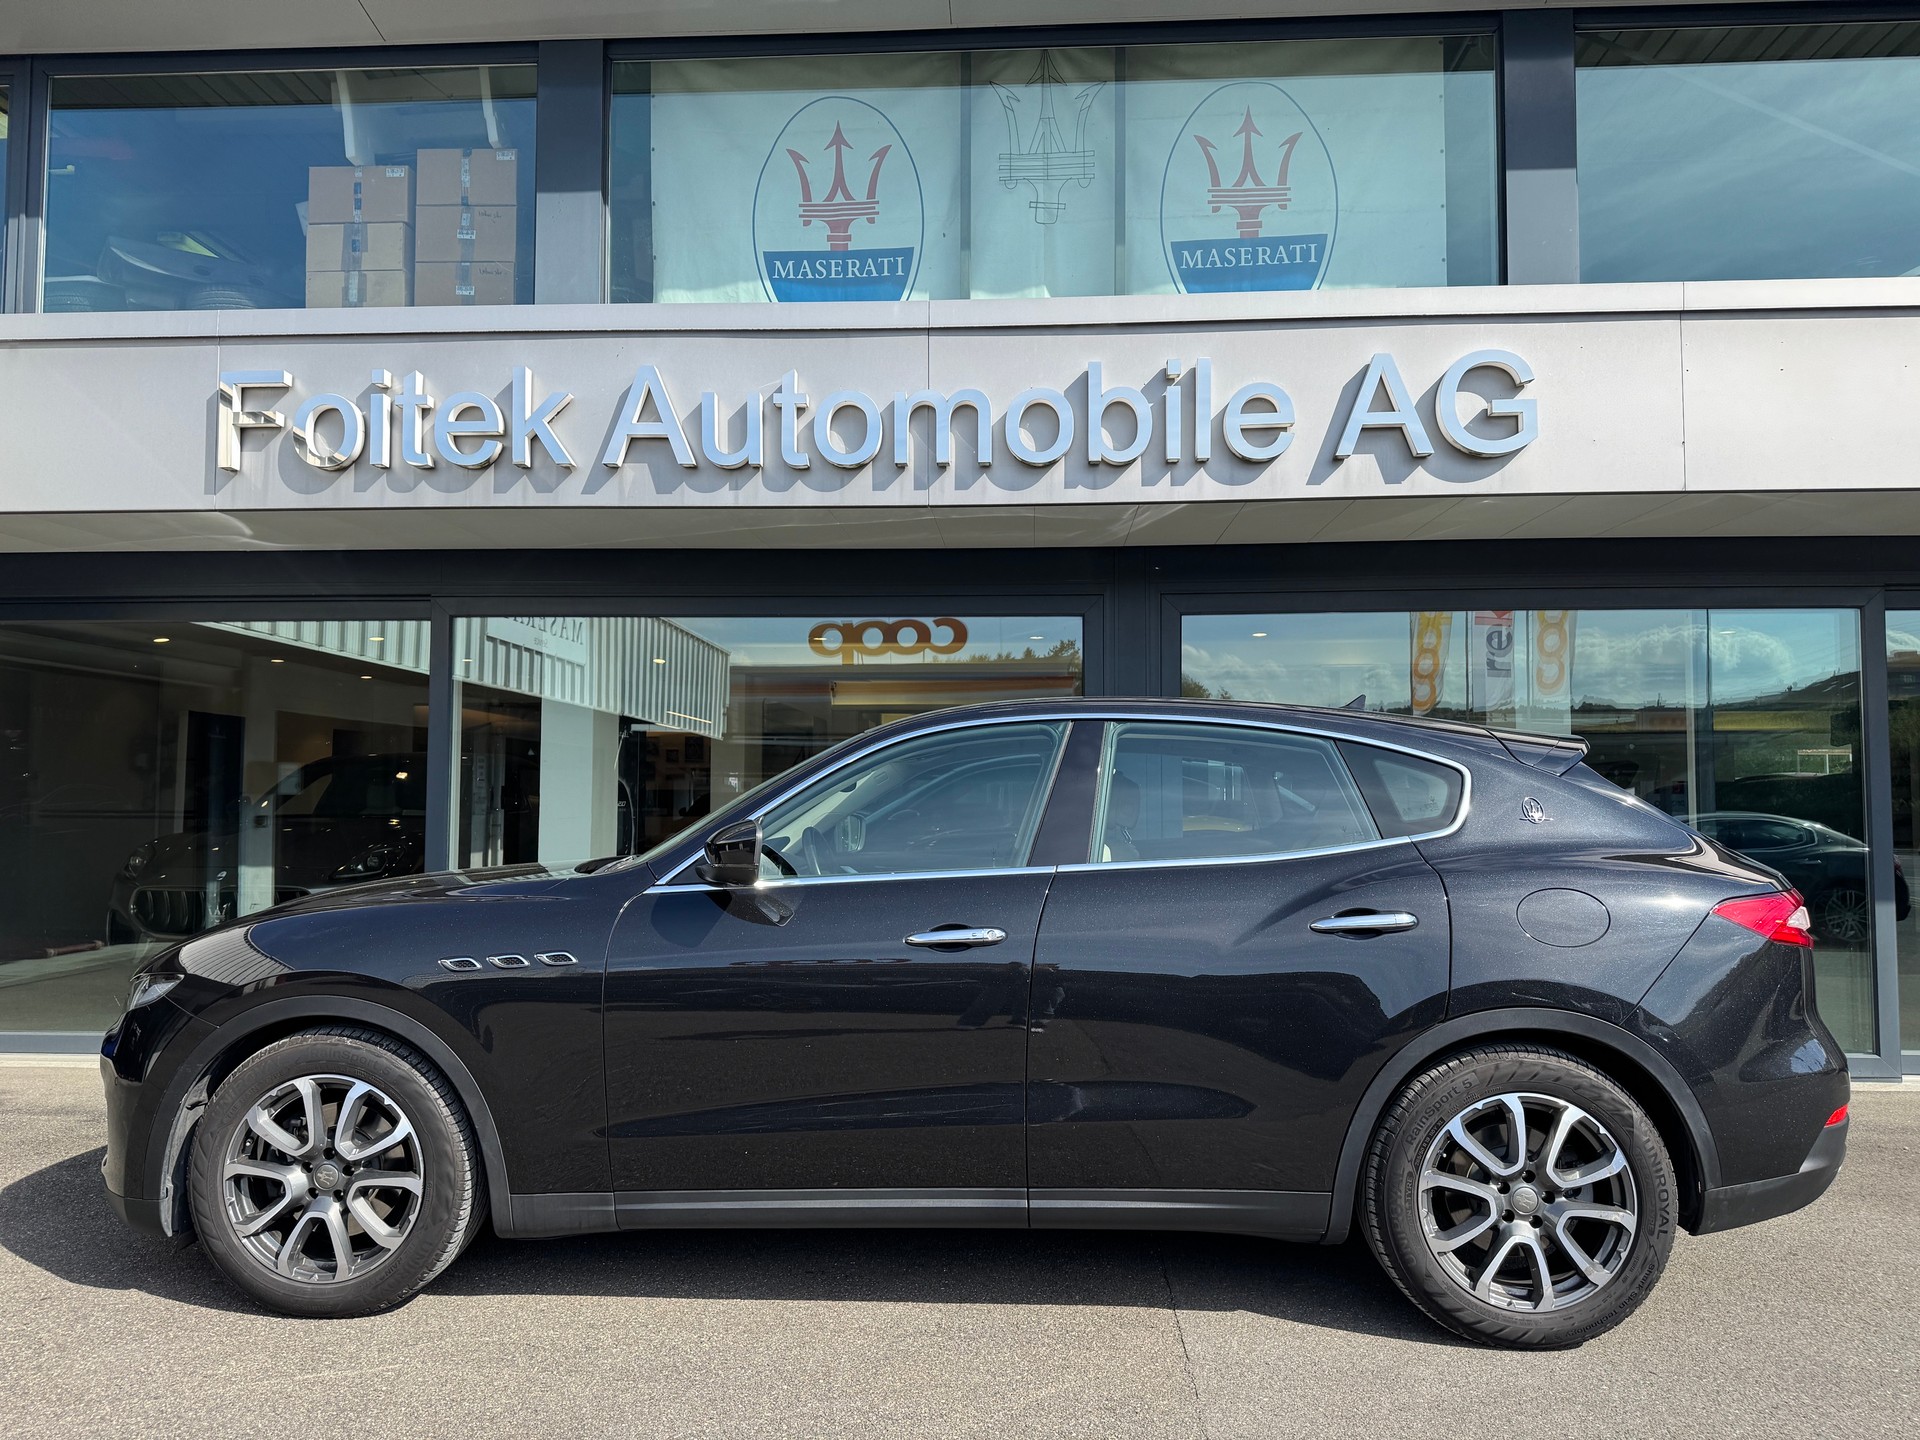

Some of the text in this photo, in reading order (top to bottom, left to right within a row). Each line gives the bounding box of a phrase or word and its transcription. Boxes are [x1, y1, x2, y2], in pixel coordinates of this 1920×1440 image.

[772, 256, 905, 279] MASERATI
[1180, 243, 1318, 269] MASERATI
[218, 350, 1539, 472] Foitek Automobile AG
[1403, 1083, 1461, 1145] RainSport
[1460, 1077, 1473, 1090] 5
[1641, 1137, 1669, 1241] UNIROYAL
